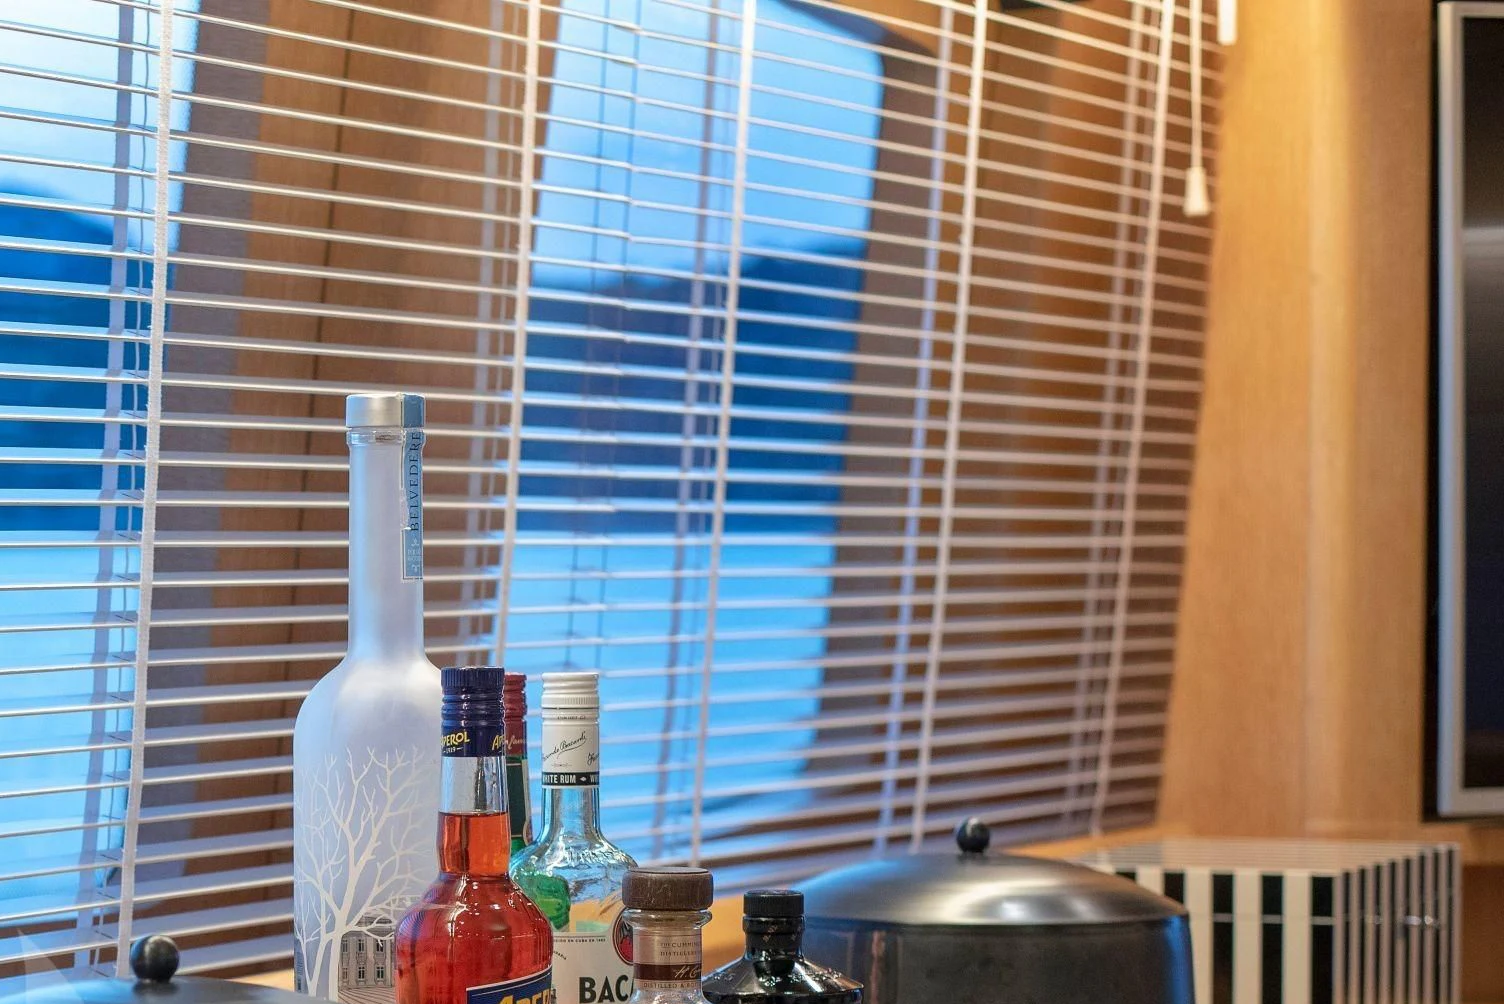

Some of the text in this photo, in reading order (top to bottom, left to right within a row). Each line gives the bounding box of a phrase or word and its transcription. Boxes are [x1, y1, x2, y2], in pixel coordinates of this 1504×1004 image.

[410, 431, 422, 532] BELVEDERE
[560, 774, 577, 784] RUM
[579, 974, 634, 1004] BAC
